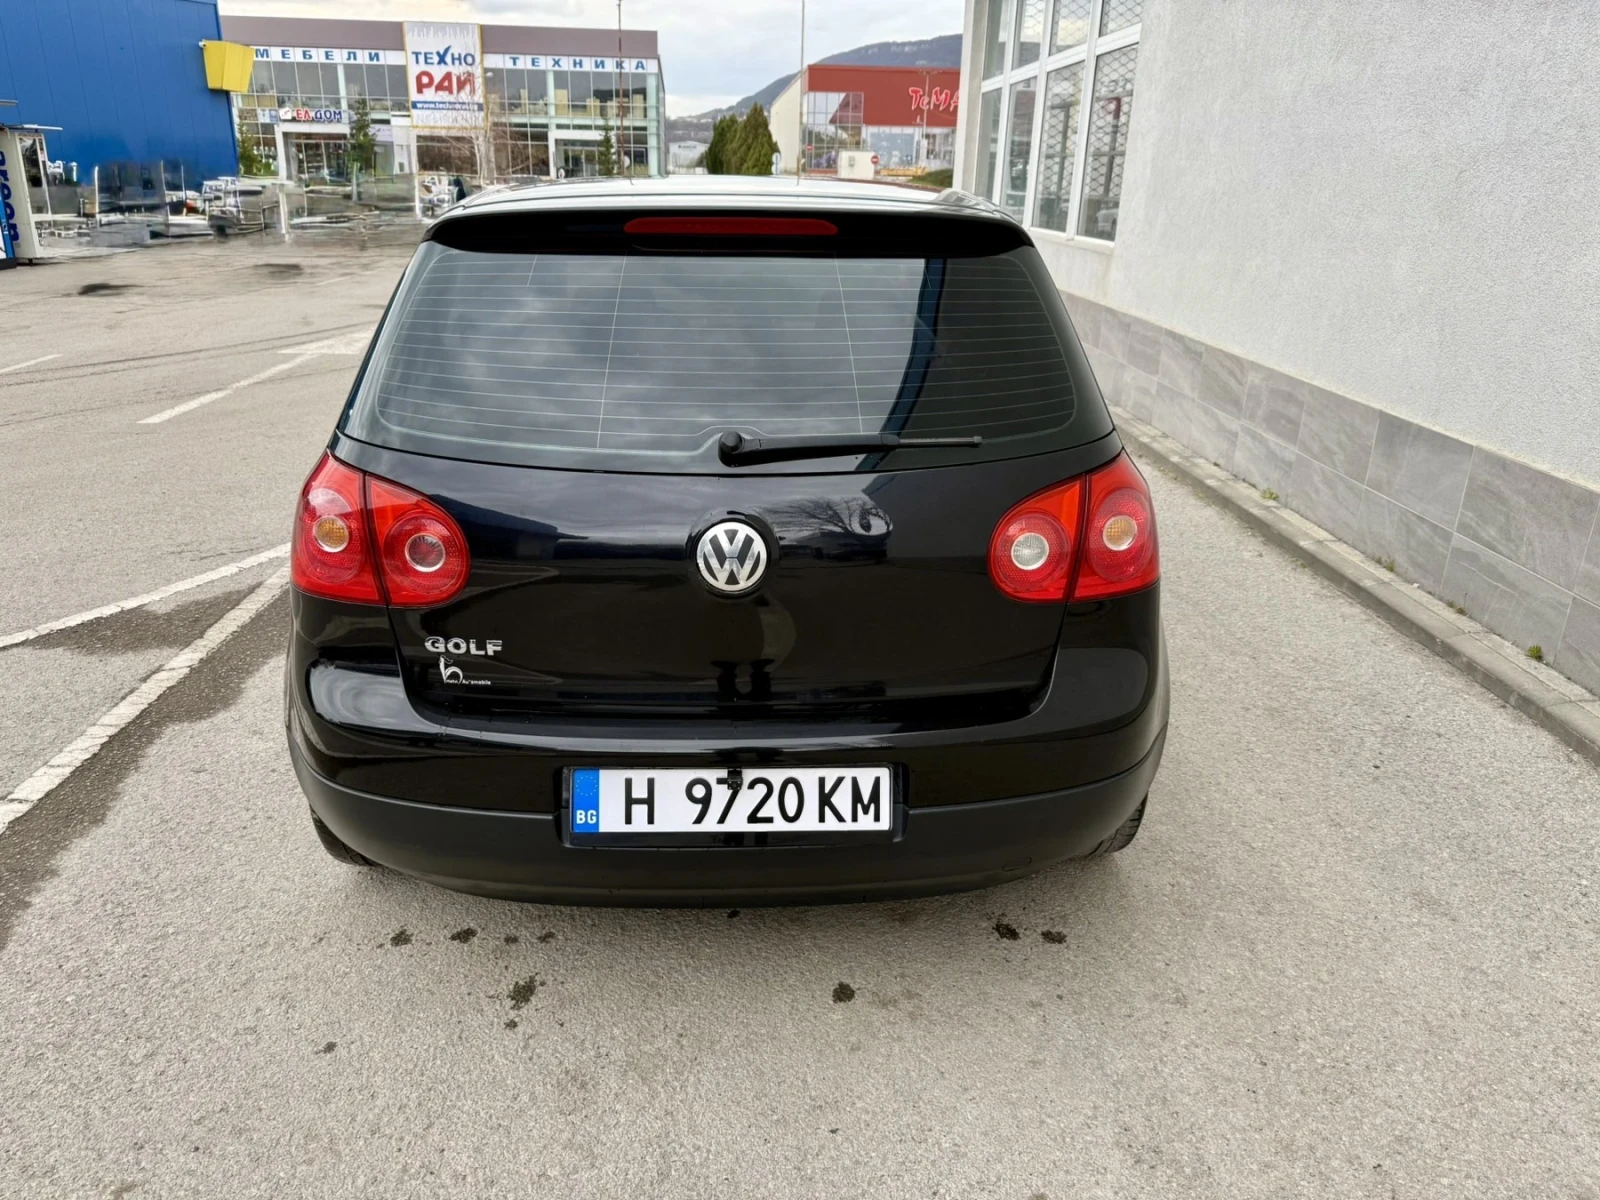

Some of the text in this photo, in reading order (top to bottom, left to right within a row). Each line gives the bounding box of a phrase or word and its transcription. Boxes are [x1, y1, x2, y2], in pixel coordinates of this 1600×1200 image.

[255, 48, 380, 63] МЕБЕЛИ
[411, 44, 476, 66] ТЕХНО
[509, 56, 646, 71] ТЕХНИКА
[424, 636, 503, 656] GOLF
[624, 776, 881, 825] H 9720 KM
[576, 809, 597, 825] BG
